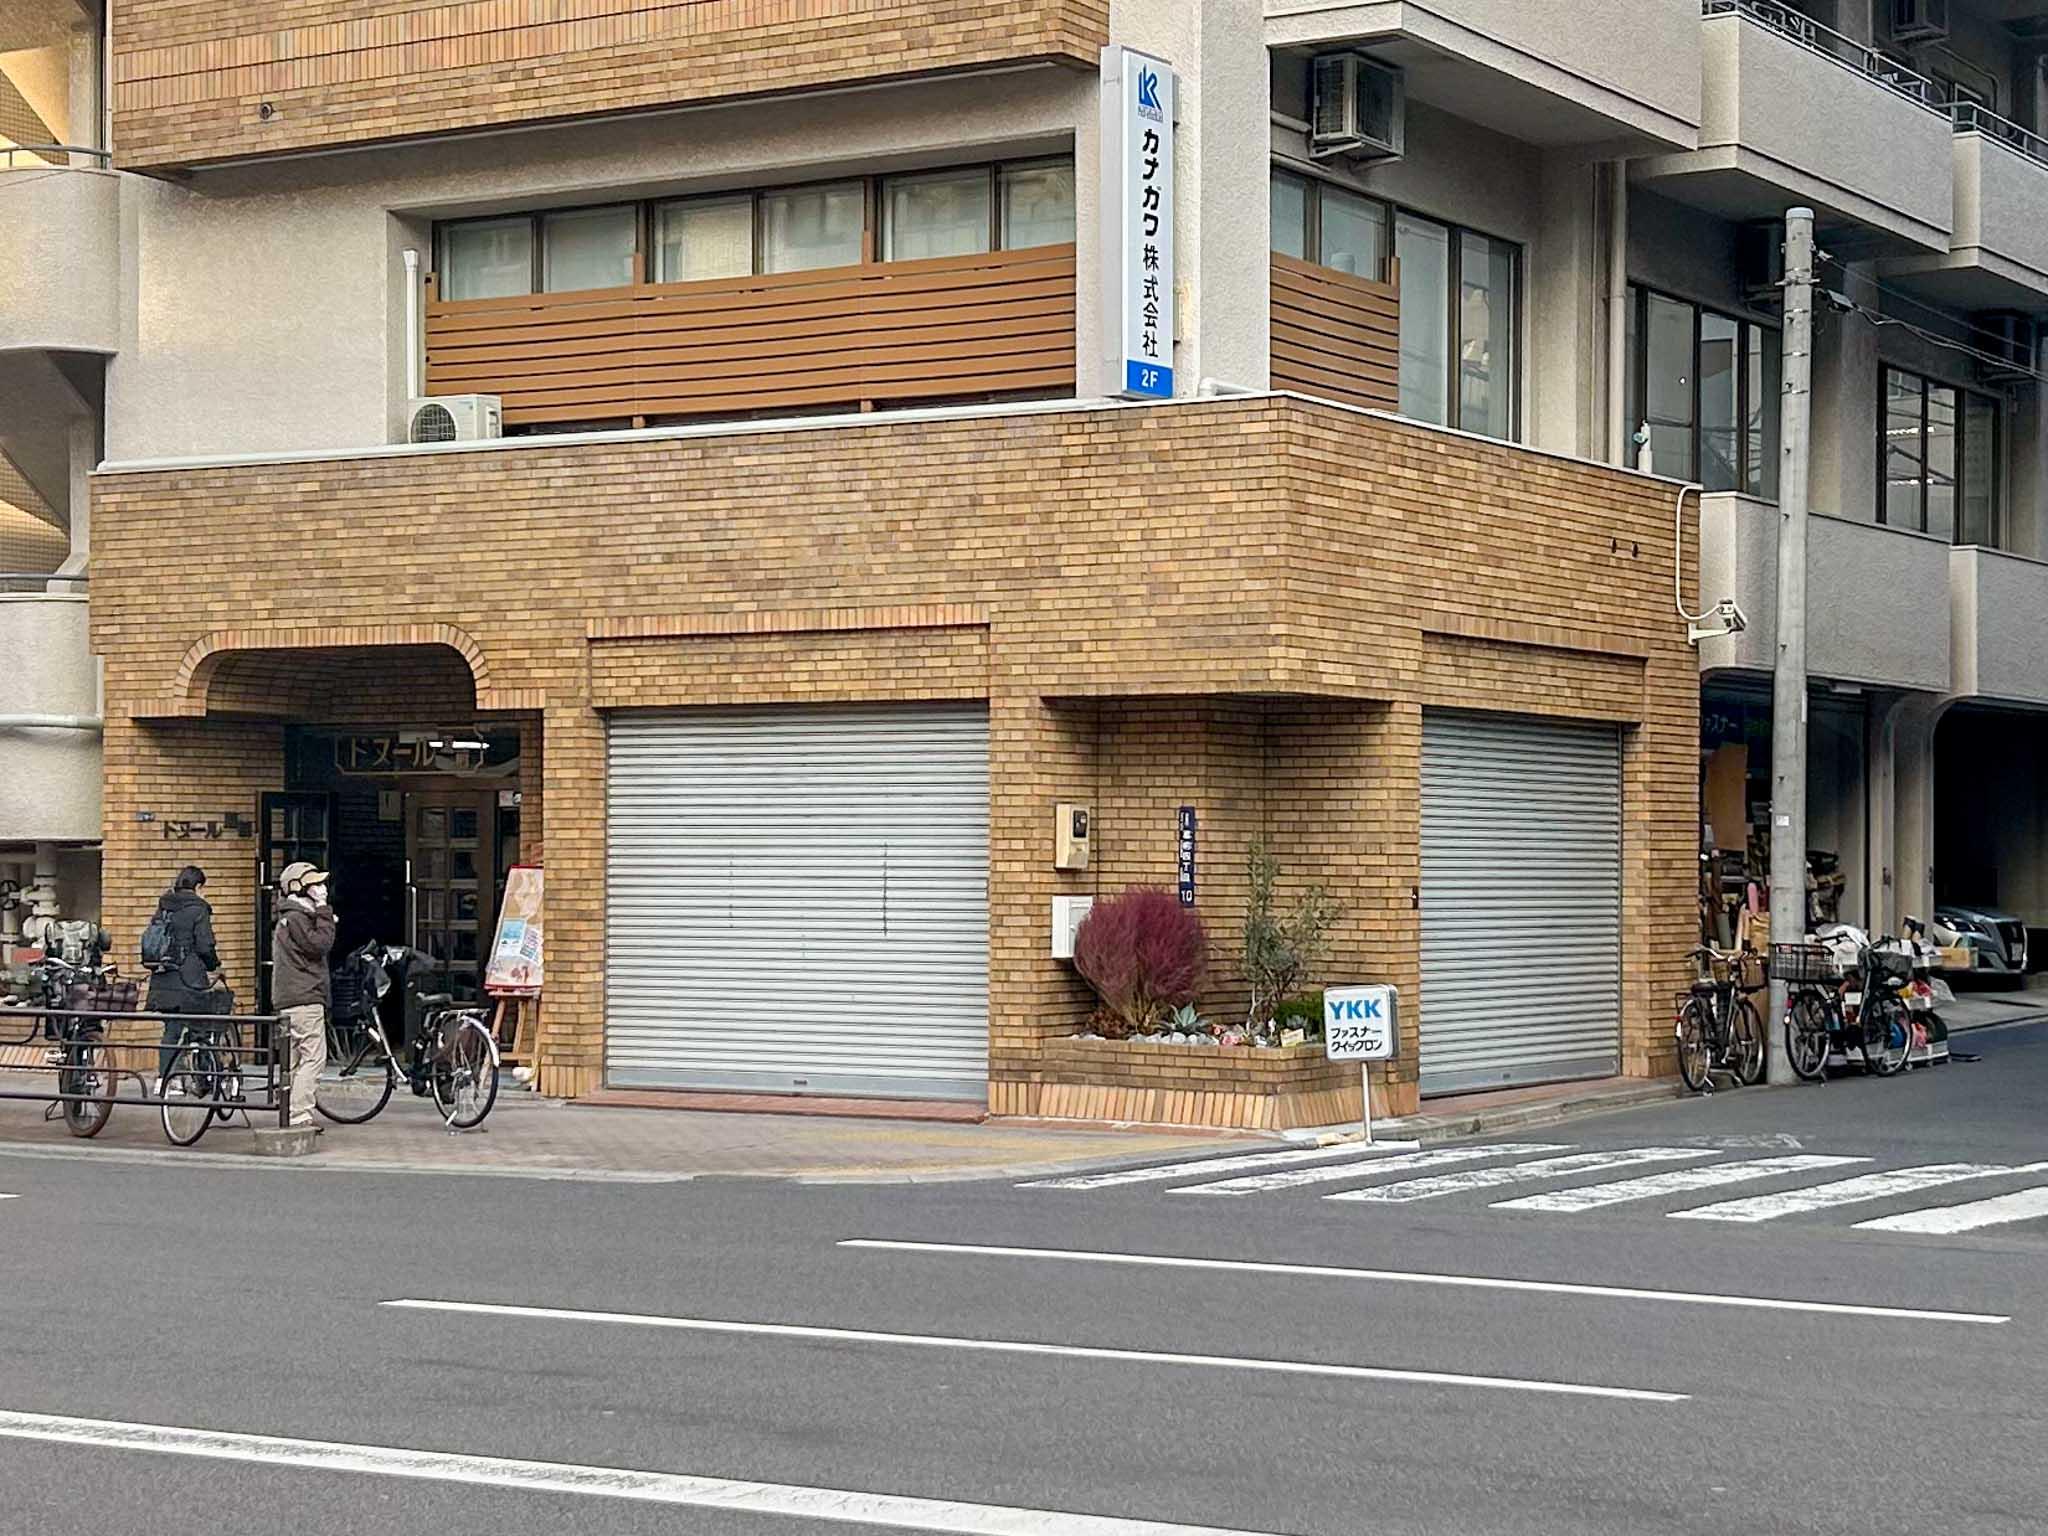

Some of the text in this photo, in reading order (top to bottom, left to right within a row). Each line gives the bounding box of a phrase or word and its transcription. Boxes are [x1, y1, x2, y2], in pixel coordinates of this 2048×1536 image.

[1142, 128, 1160, 359] カナガワ株式会社
[1140, 369, 1158, 388] 2F
[1181, 889, 1193, 902] 10
[1328, 999, 1382, 1020] YKK
[1331, 1026, 1382, 1039] ファスナー
